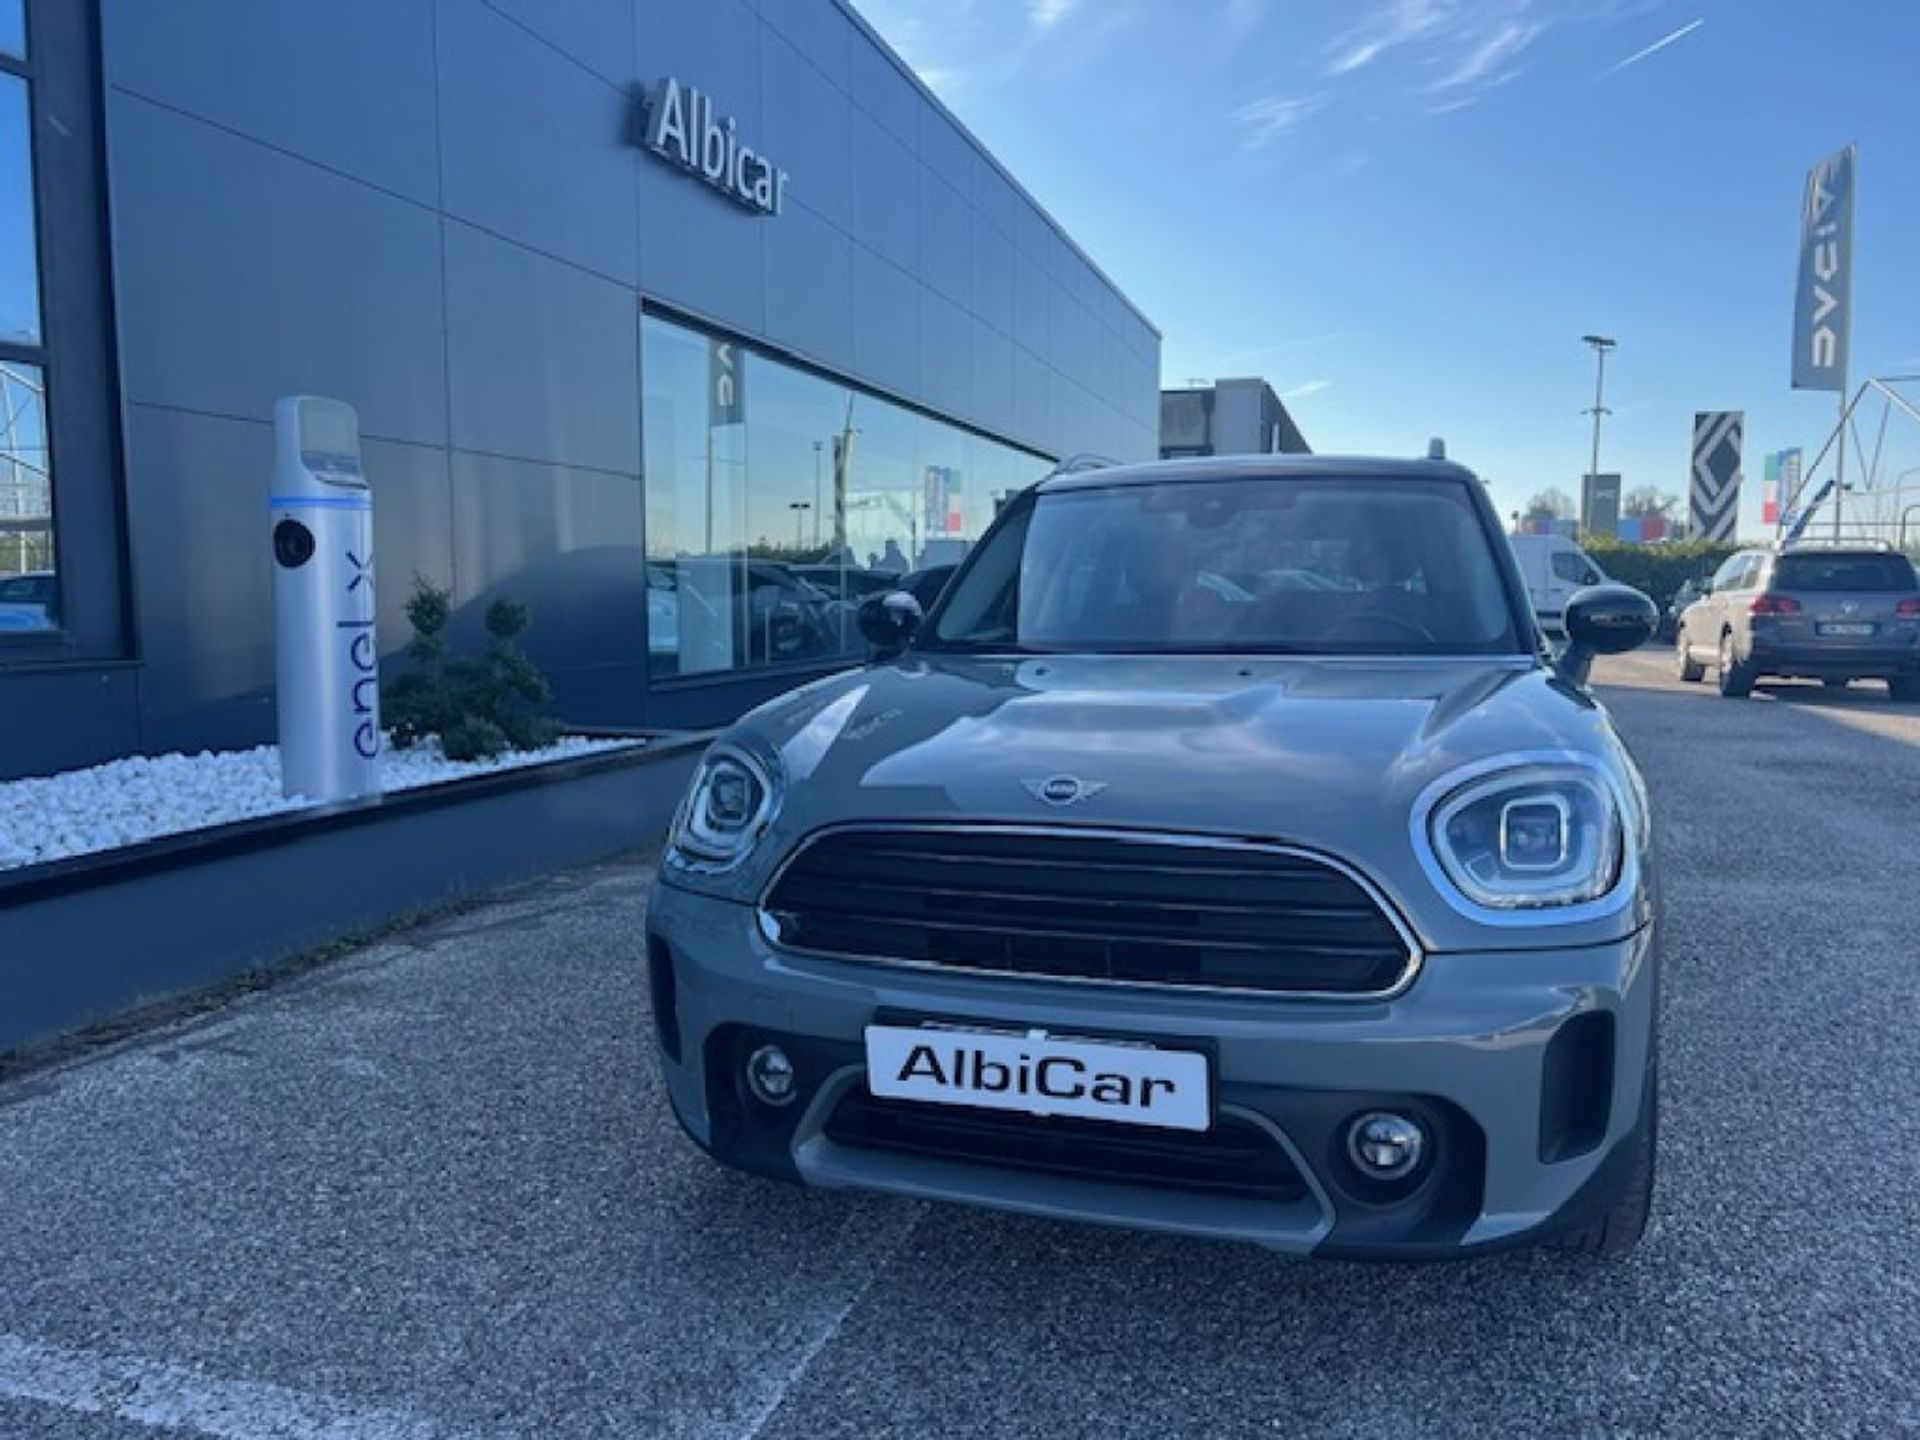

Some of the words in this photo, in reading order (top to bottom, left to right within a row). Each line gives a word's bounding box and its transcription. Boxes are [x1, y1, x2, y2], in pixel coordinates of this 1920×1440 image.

[652, 76, 790, 216] Albicar
[336, 621, 379, 760] enel
[897, 1045, 1175, 1107] AlbiCar
